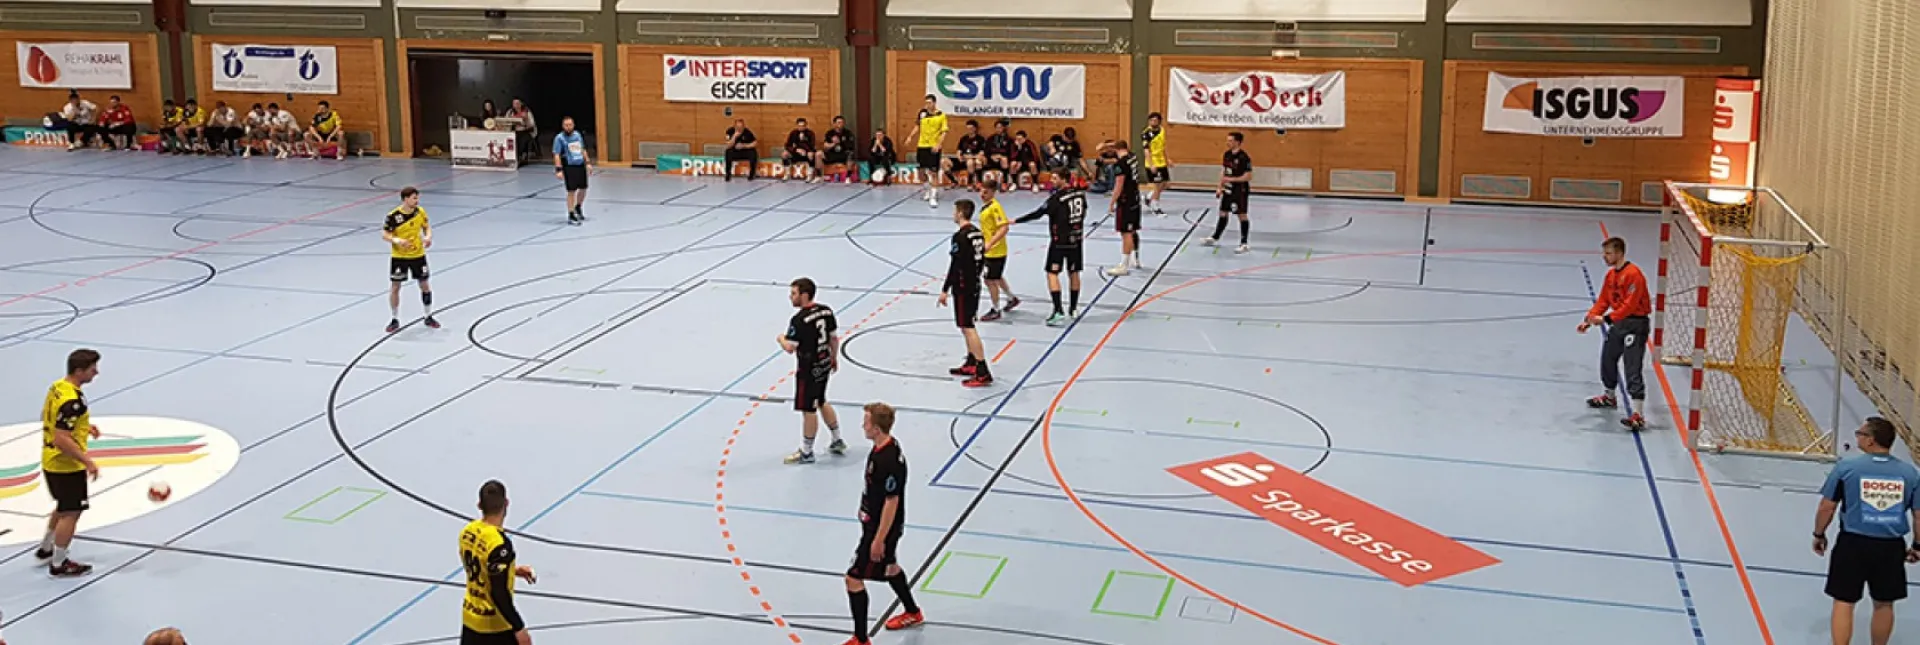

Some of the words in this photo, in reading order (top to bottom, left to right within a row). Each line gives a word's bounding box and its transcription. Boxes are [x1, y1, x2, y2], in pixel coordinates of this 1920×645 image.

[688, 60, 808, 79] INTERSPORT
[711, 81, 767, 99] EISERT
[1188, 83, 1235, 106] Der
[1240, 74, 1323, 113] Beck
[954, 105, 1004, 115] ERLANGER
[1006, 106, 1074, 116] STADTWERKE
[1533, 87, 1640, 120] ISGUS
[1543, 125, 1664, 136] UNTERNEHMENSGRUPPE
[815, 318, 827, 344] 3
[1863, 481, 1902, 491] BOSCH
[1863, 491, 1901, 500] Service
[1251, 489, 1434, 576] Sparkasse
